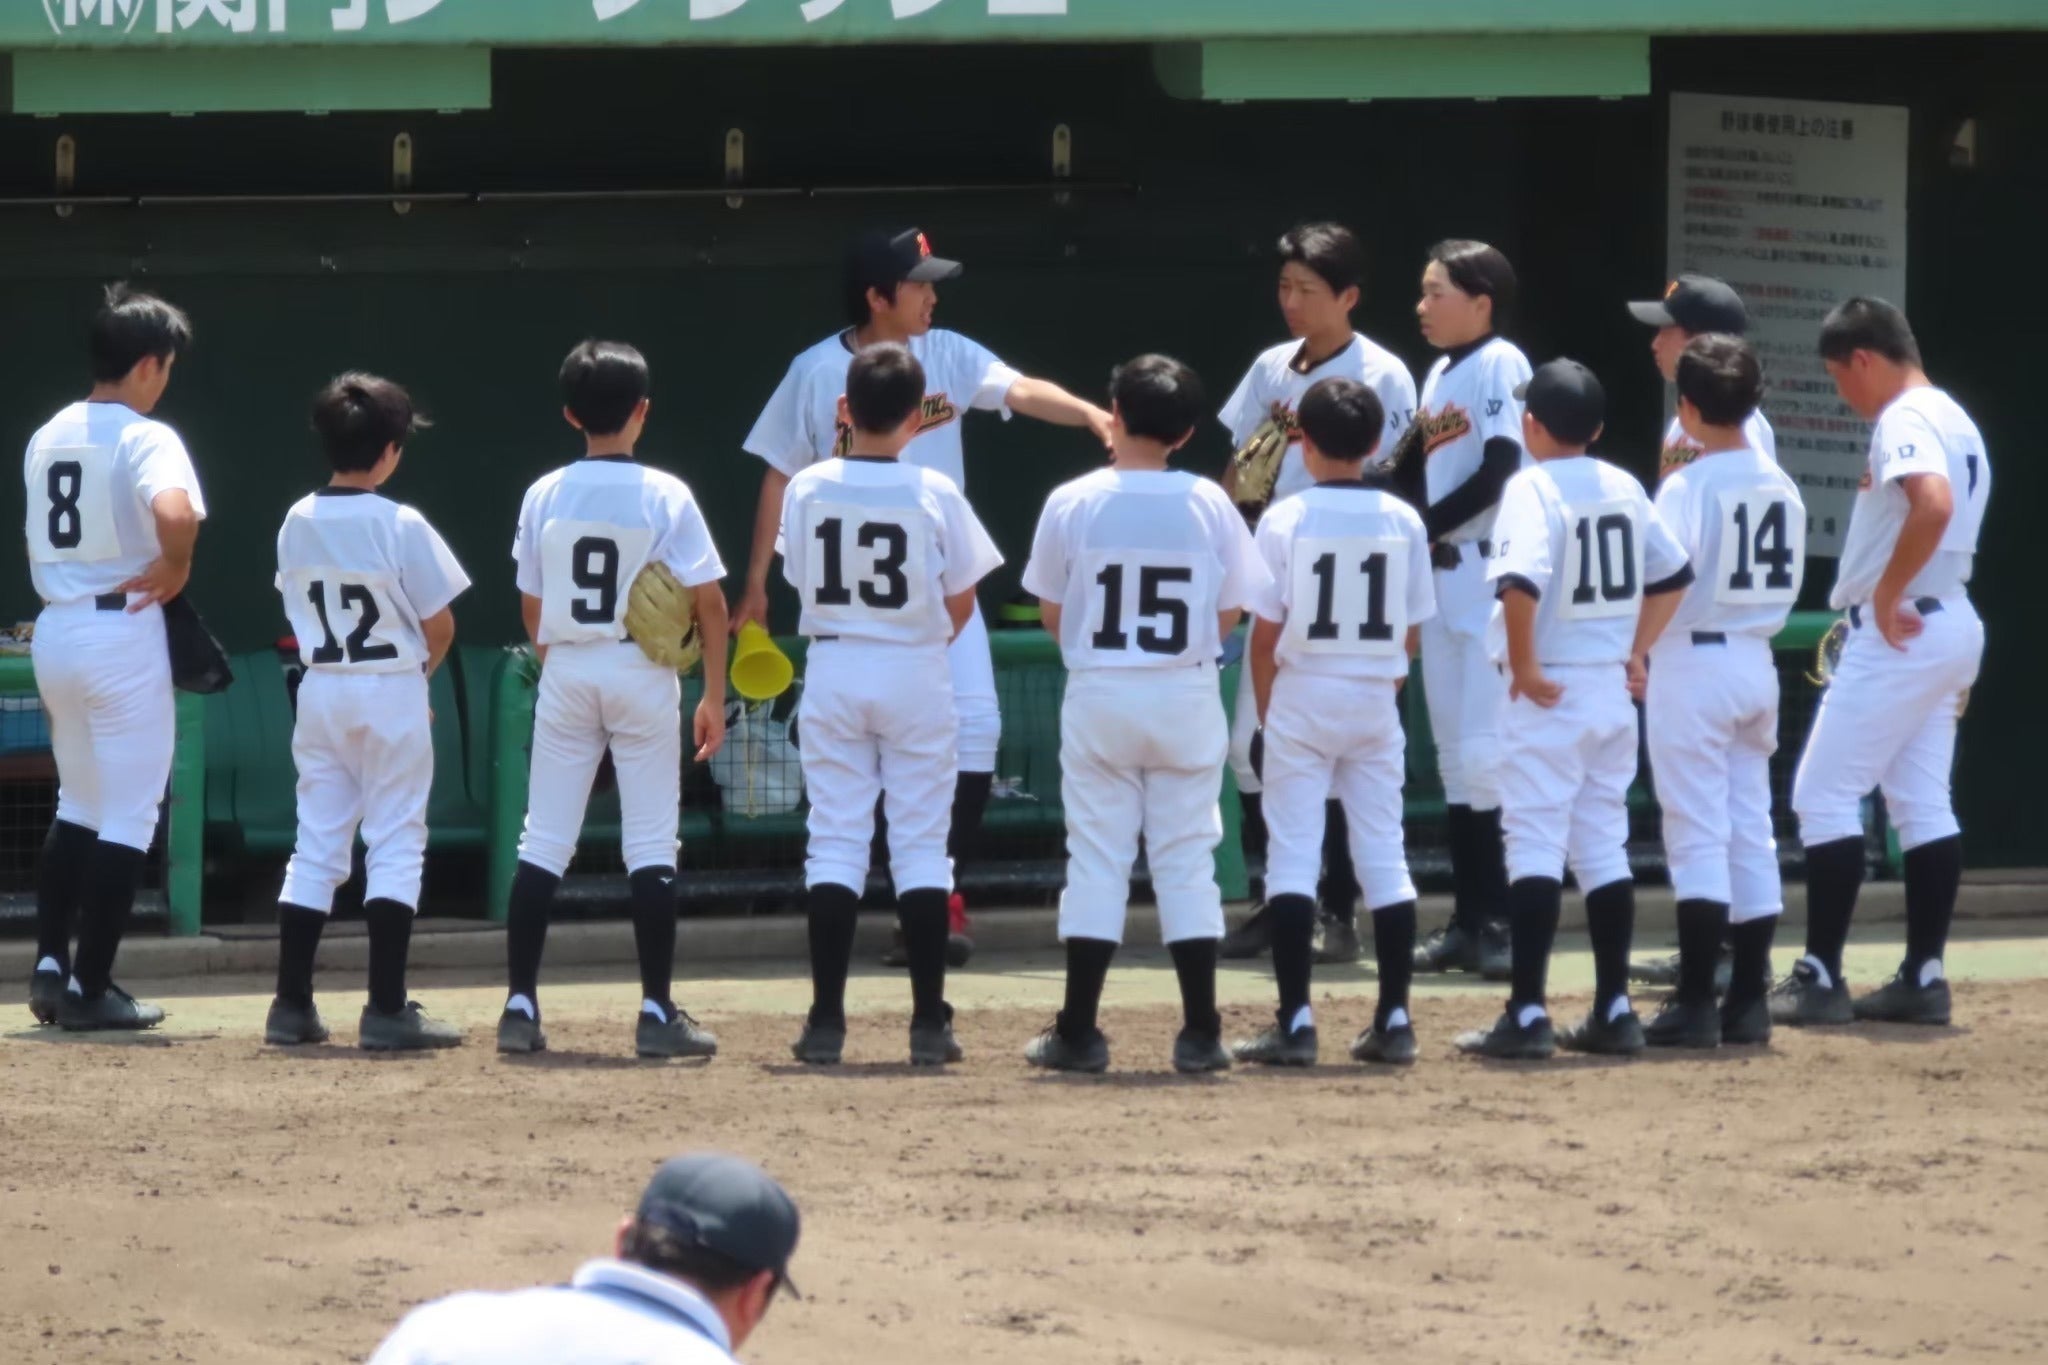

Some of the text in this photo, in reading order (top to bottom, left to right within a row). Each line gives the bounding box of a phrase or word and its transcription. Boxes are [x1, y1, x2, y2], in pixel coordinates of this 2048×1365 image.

[47, 460, 83, 550] 8
[1728, 501, 1794, 590] 14
[571, 536, 620, 625] 9
[815, 517, 909, 610] 13
[1307, 552, 1394, 641] 11
[1571, 513, 1637, 605] 10
[307, 580, 399, 664] 12
[1092, 563, 1192, 656] 15
